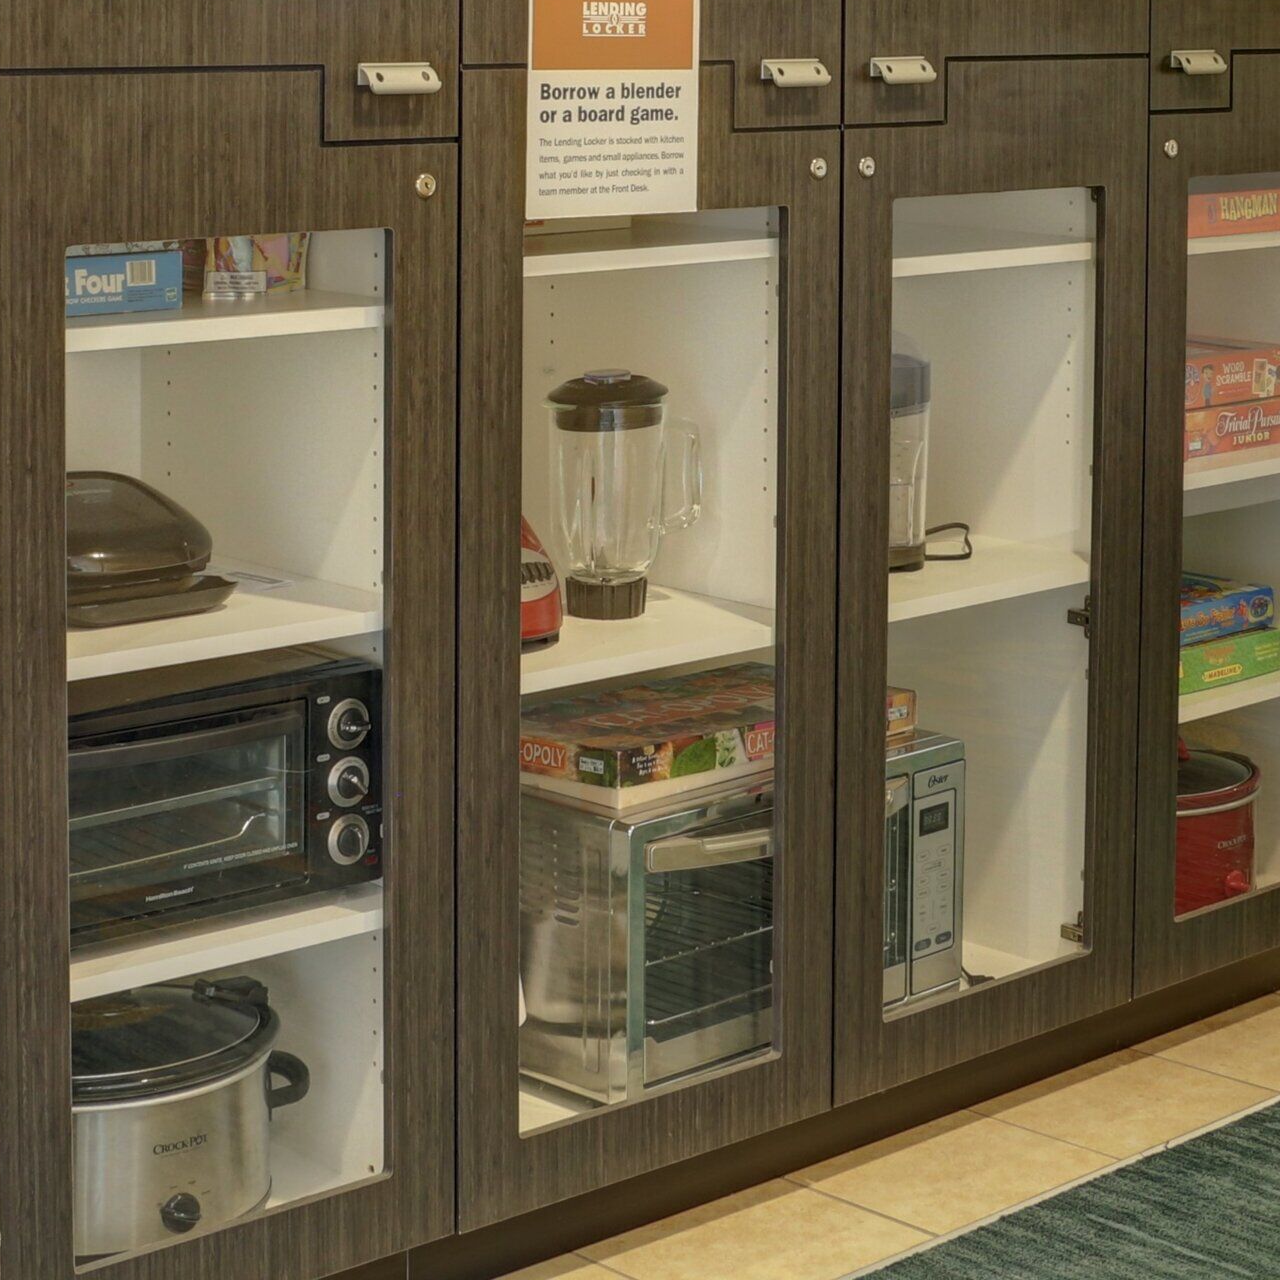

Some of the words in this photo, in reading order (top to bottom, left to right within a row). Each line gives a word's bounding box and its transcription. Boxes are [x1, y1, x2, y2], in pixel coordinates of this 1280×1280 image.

[583, 1, 647, 16] LENDING
[583, 23, 646, 34] LOCKER
[540, 83, 600, 100] Borrow
[606, 86, 615, 99] a
[621, 82, 681, 99] blender
[540, 109, 557, 123] or
[563, 109, 572, 122] a
[578, 105, 625, 122] board
[630, 107, 678, 125] game.
[539, 138, 552, 146] The
[554, 137, 582, 148] Lending
[584, 136, 607, 145] Locker
[609, 136, 615, 144] is
[616, 136, 642, 144] stocked
[644, 136, 659, 144] with
[660, 135, 684, 144] kitchen
[563, 154, 587, 164] games
[588, 153, 601, 161] and
[602, 152, 621, 161] small
[622, 152, 660, 162] appliances.
[661, 151, 684, 160] Borrow
[538, 171, 556, 179] what
[559, 169, 578, 181] you'd
[580, 169, 593, 178] like
[595, 169, 604, 179] by
[605, 169, 618, 179] just
[621, 168, 652, 178] checking
[653, 167, 661, 176] in
[663, 166, 677, 175] with
[538, 188, 558, 196] team
[559, 186, 589, 195] member
[590, 186, 598, 194] at
[599, 185, 610, 194] the
[611, 184, 629, 193] Front
[630, 183, 650, 192] Desk.
[1220, 193, 1278, 221] HANGMAN
[75, 269, 125, 295] Four
[1222, 361, 1244, 374] WORD
[1216, 371, 1252, 386] SCRAMBLE
[1215, 411, 1251, 437] Trivial
[1232, 431, 1270, 445] JUNIOR
[747, 729, 775, 753] CAT-
